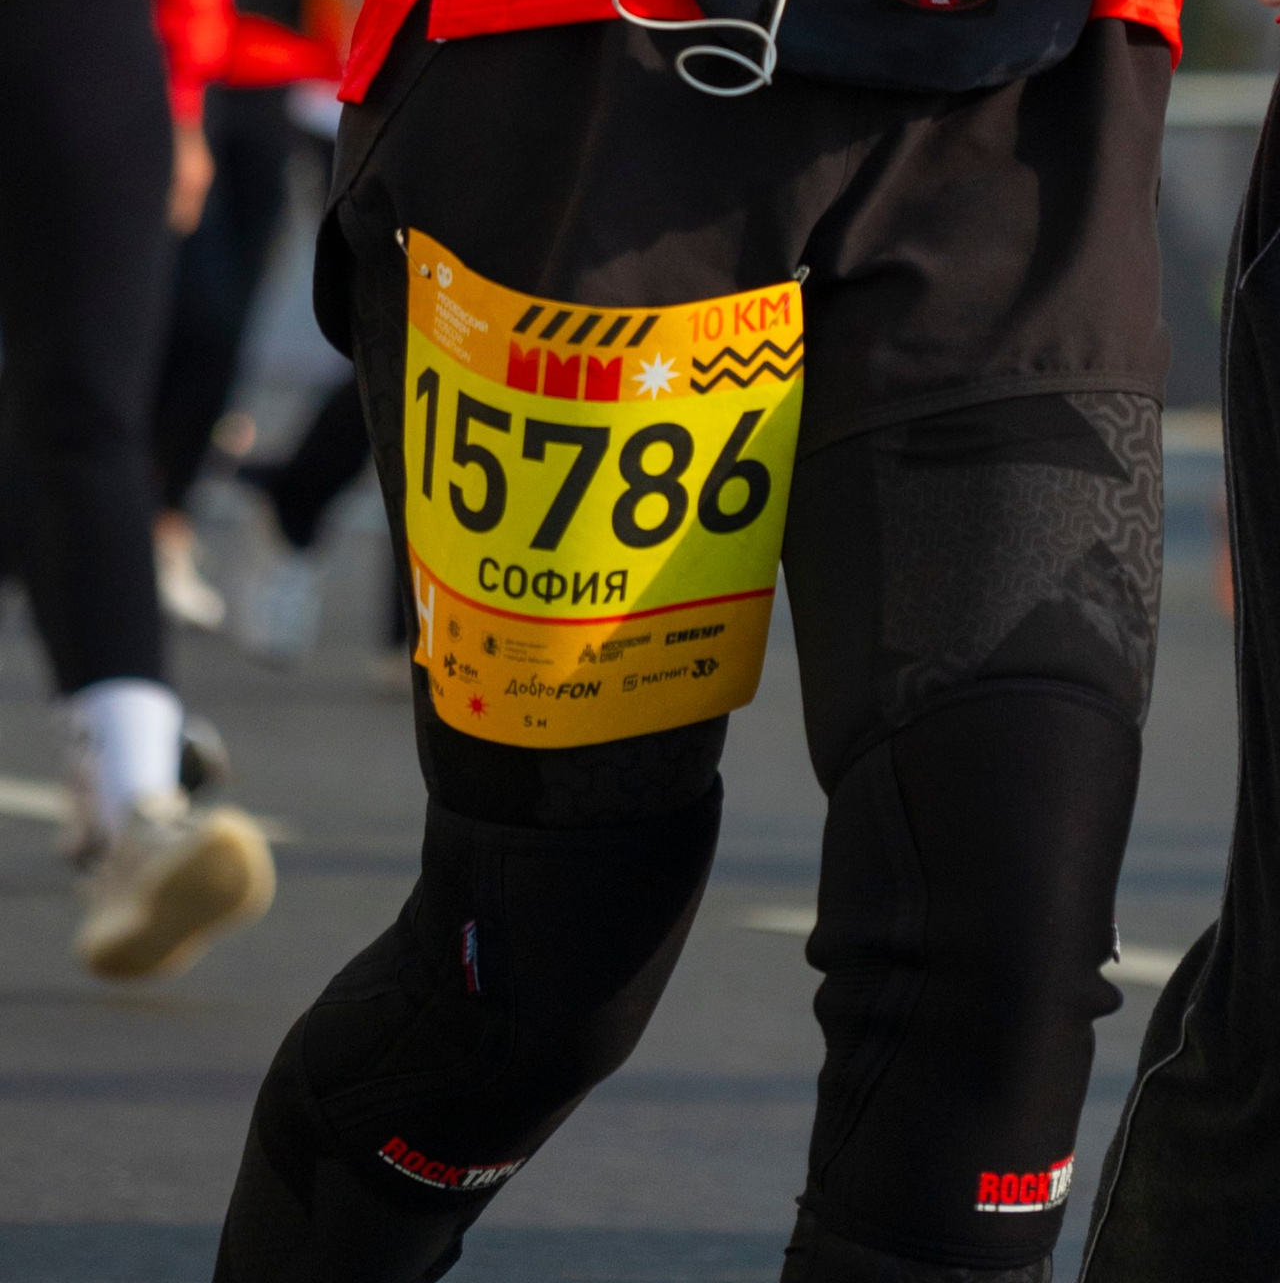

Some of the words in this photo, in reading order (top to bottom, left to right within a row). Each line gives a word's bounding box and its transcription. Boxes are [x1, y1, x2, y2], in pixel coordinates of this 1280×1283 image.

[687, 305, 724, 344] 10
[415, 365, 772, 552] 15786
[477, 556, 629, 606] СОФИЯ
